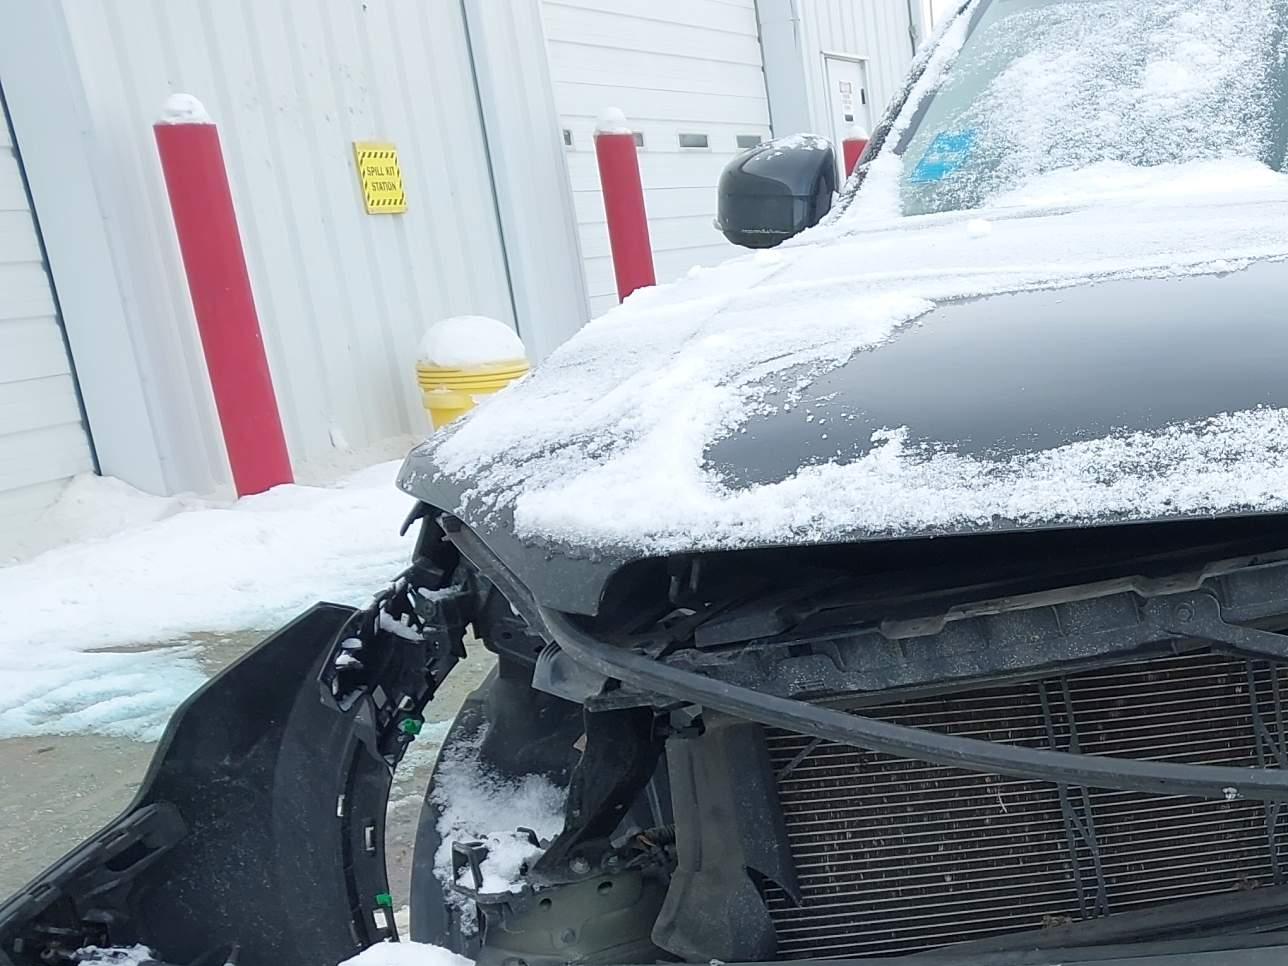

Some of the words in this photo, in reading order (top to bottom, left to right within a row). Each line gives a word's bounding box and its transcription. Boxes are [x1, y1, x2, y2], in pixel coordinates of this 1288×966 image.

[366, 166, 385, 177] SPILL
[385, 166, 396, 176] KIT
[371, 181, 397, 192] STATION
